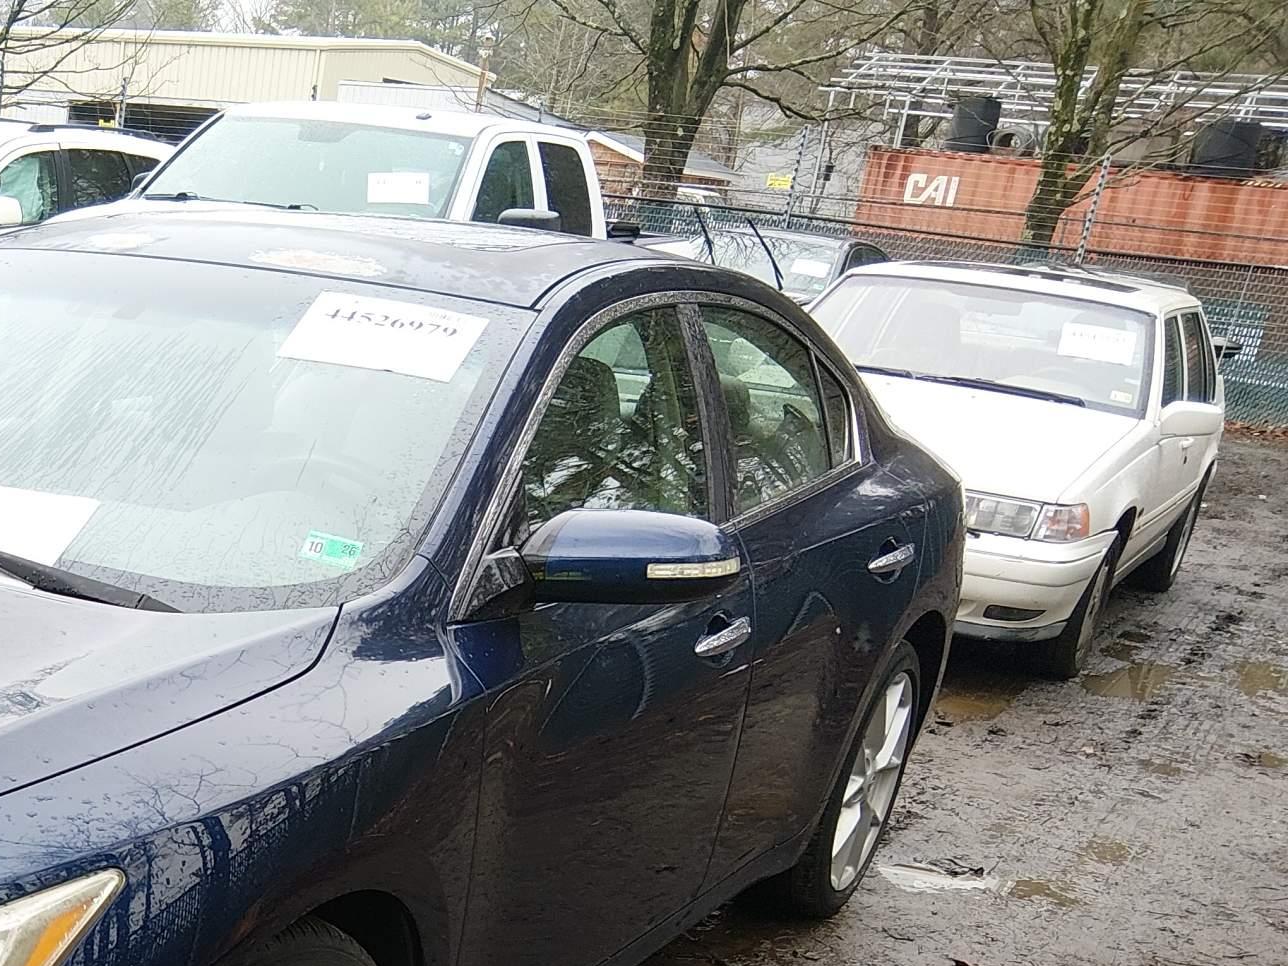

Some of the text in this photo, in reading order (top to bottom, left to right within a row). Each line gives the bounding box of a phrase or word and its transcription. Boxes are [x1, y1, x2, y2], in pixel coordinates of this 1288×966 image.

[903, 173, 960, 207] CAI
[325, 308, 458, 337] 44526979
[308, 541, 324, 554] 10
